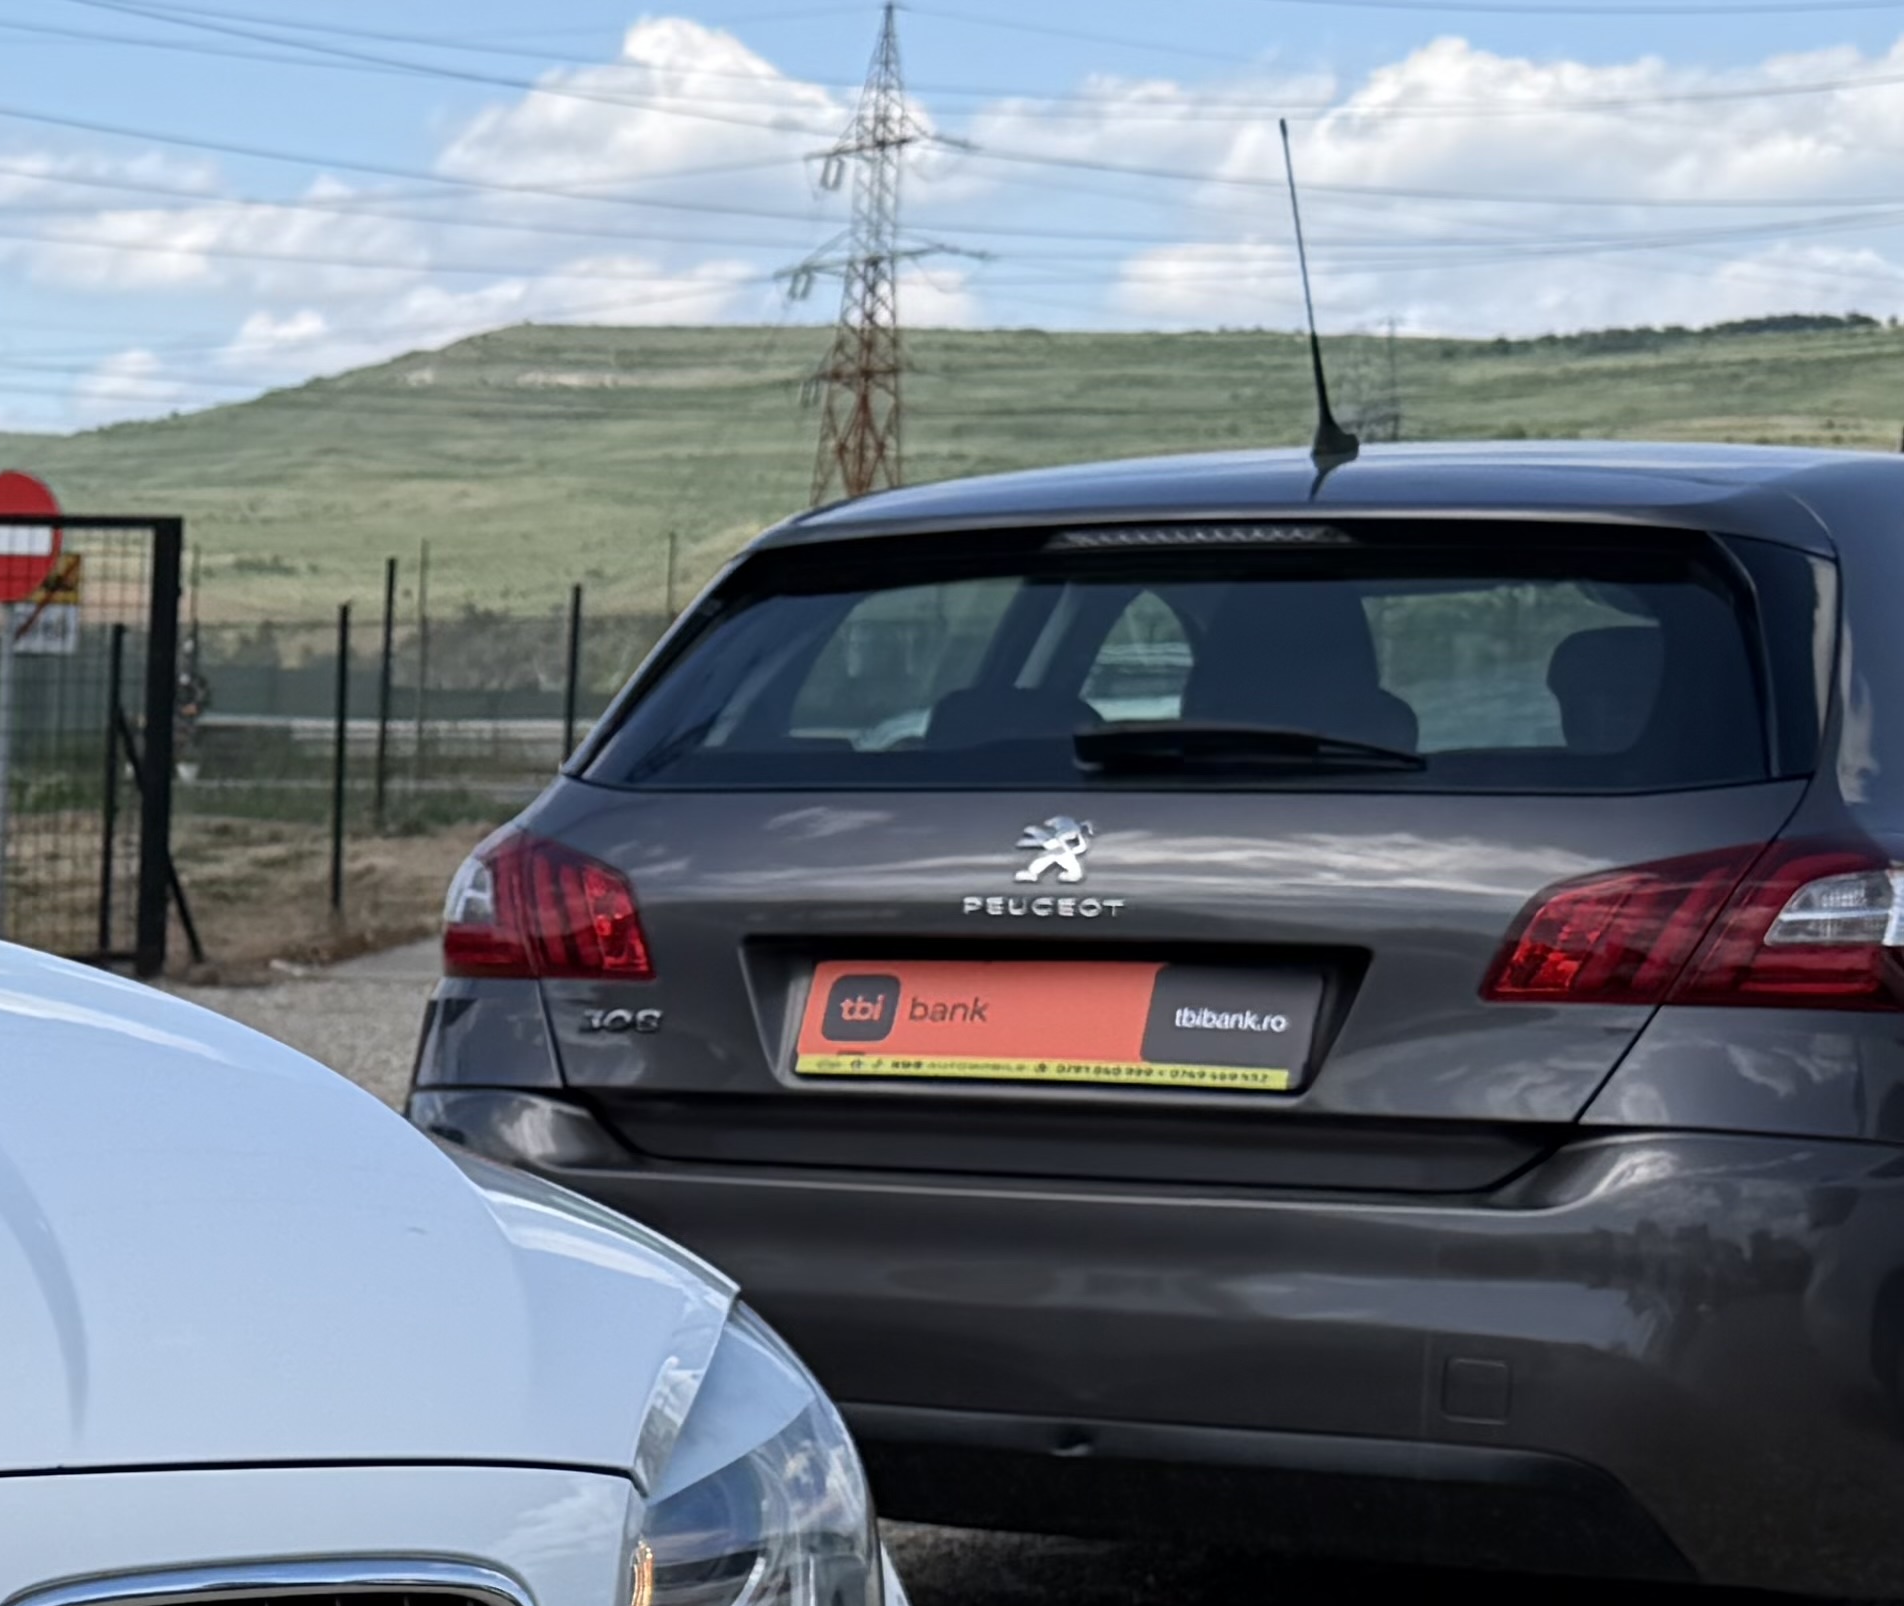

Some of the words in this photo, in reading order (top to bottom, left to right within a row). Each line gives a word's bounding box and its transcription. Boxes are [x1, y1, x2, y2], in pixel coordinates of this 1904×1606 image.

[963, 896, 1125, 917] PEUGEOT
[840, 994, 885, 1021] tbi
[909, 996, 990, 1022] bank
[1175, 1007, 1289, 1032] tbibank.ro
